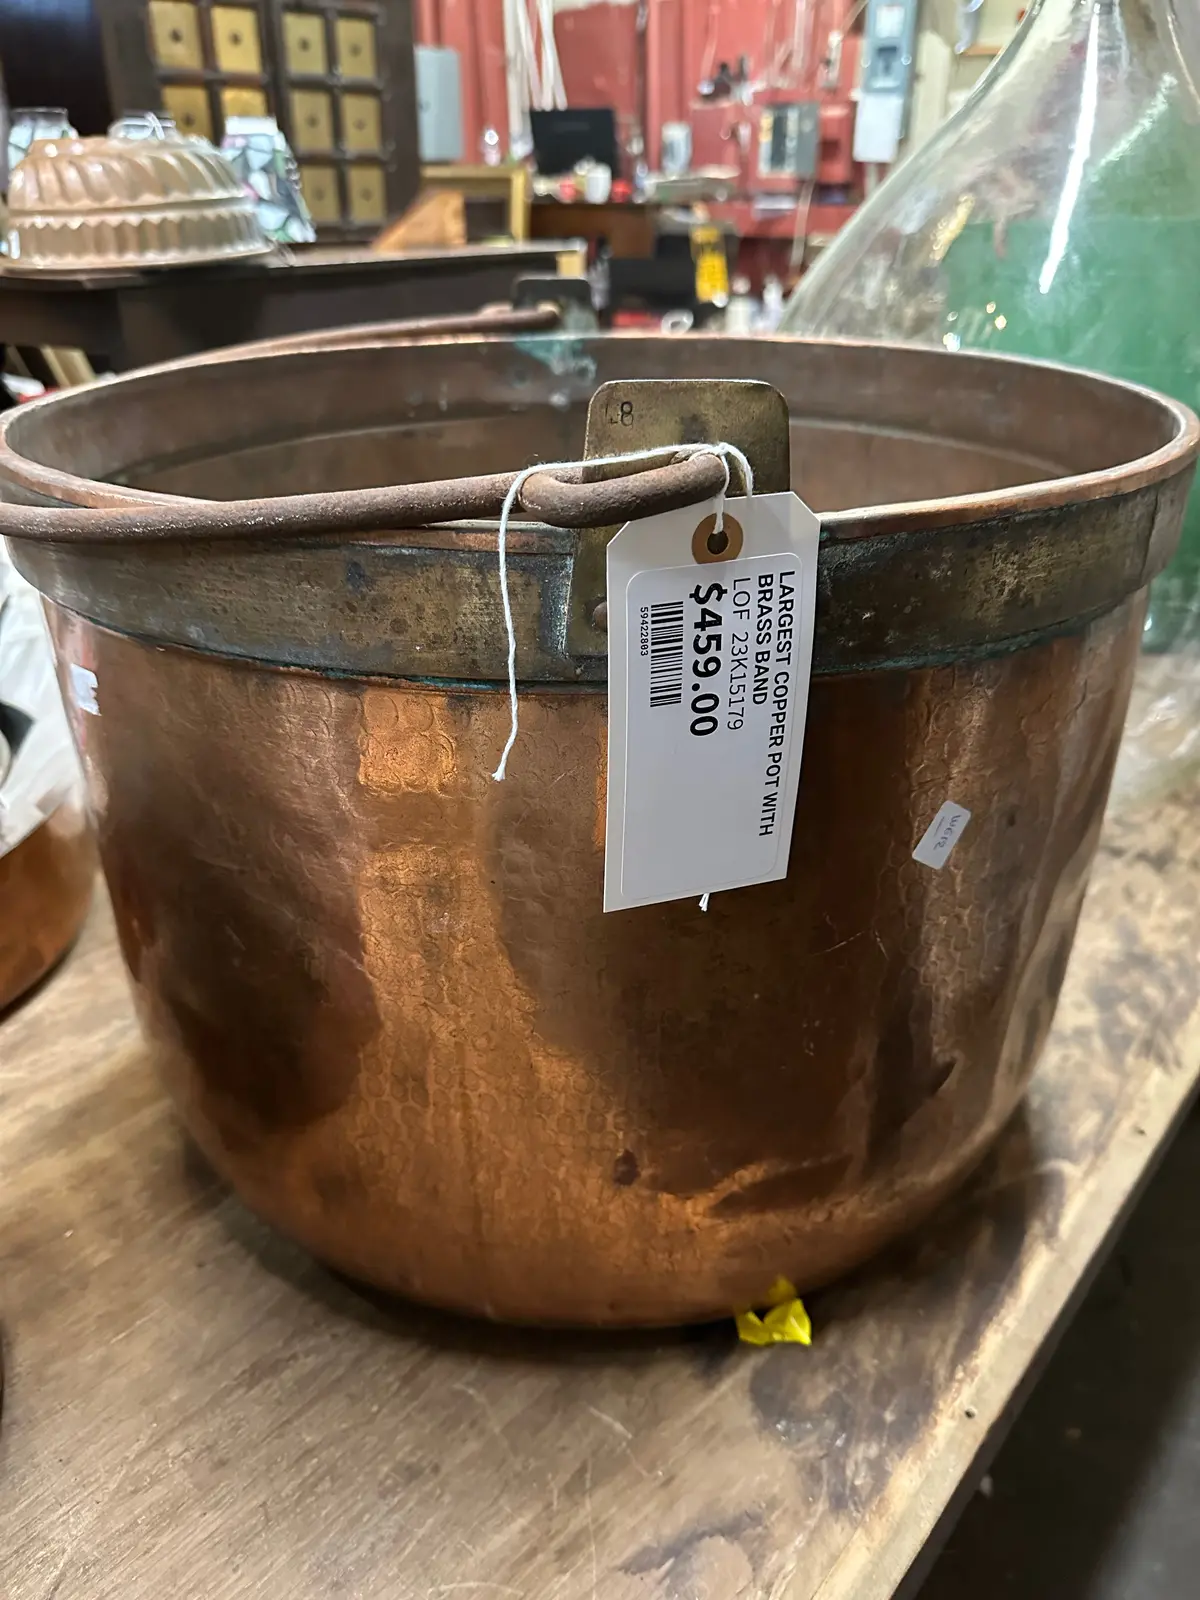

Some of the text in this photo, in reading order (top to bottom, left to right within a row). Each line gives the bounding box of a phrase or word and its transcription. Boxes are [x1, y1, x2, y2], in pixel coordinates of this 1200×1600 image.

[688, 582, 728, 737] $459.00
[727, 577, 752, 731] LOF 23K15179
[752, 573, 774, 705] BRASS BAND
[758, 570, 796, 837] LARGEST COPPER POT WITH
